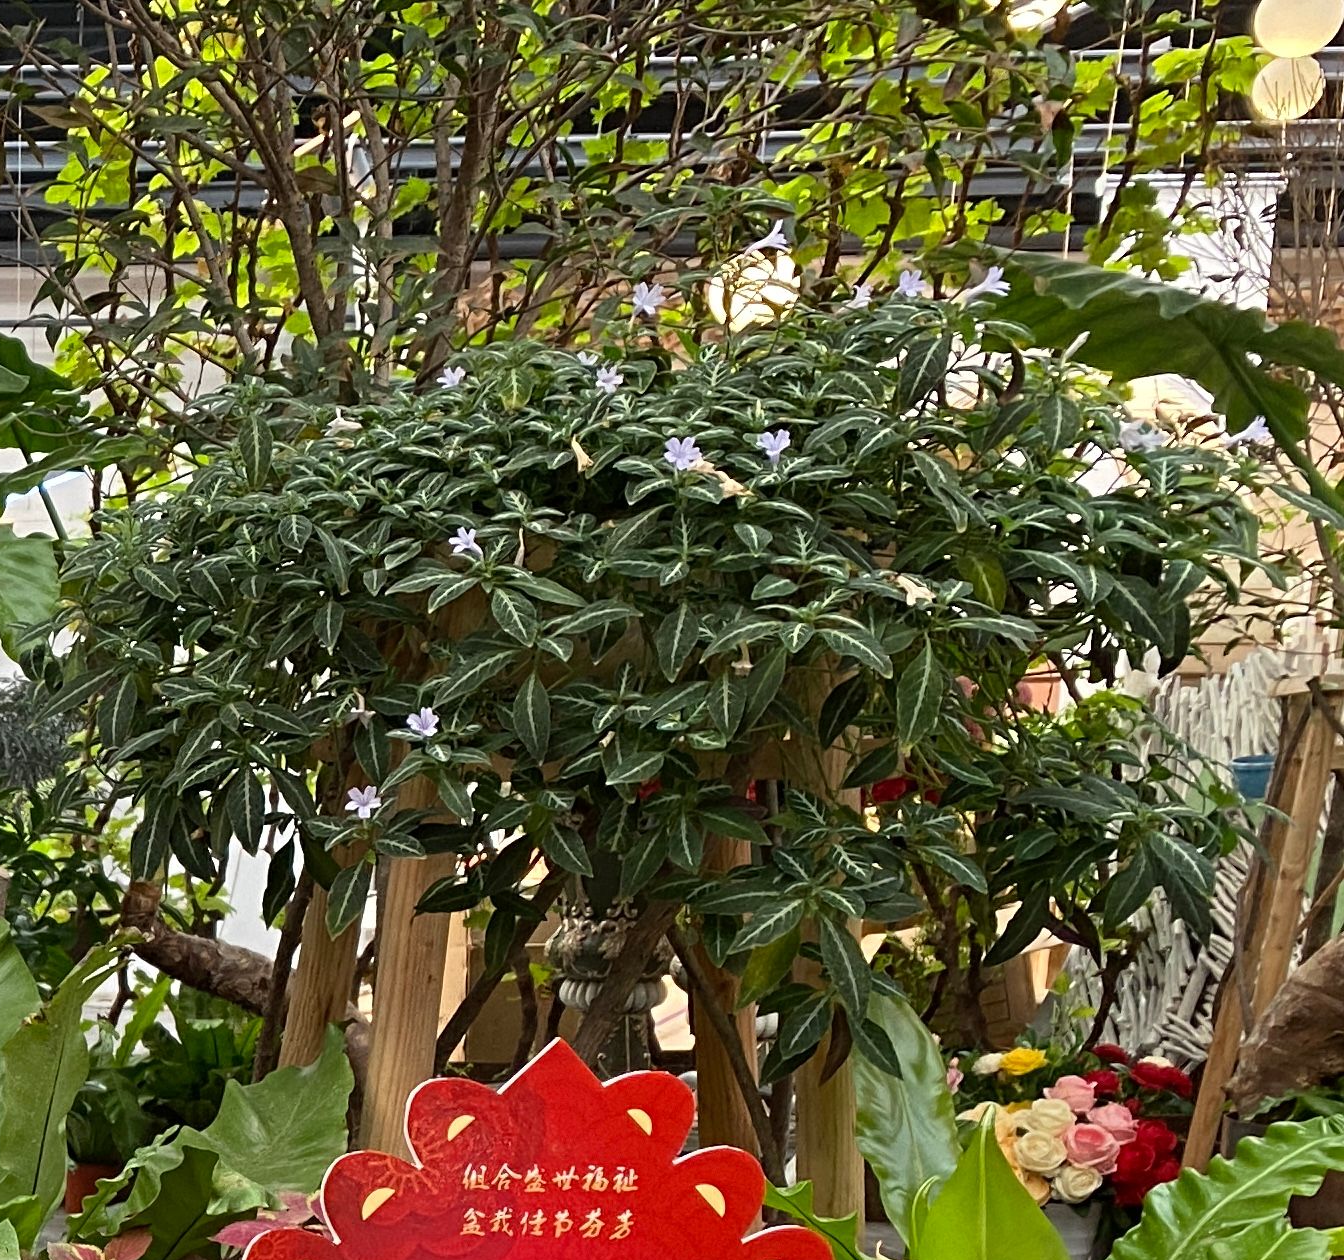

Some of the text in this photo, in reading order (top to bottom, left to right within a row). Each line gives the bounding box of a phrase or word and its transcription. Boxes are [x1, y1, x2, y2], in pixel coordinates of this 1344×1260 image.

[462, 1162, 639, 1193] 组合盛世福祉
[459, 1206, 634, 1240] 盆栽佳节芬芳
